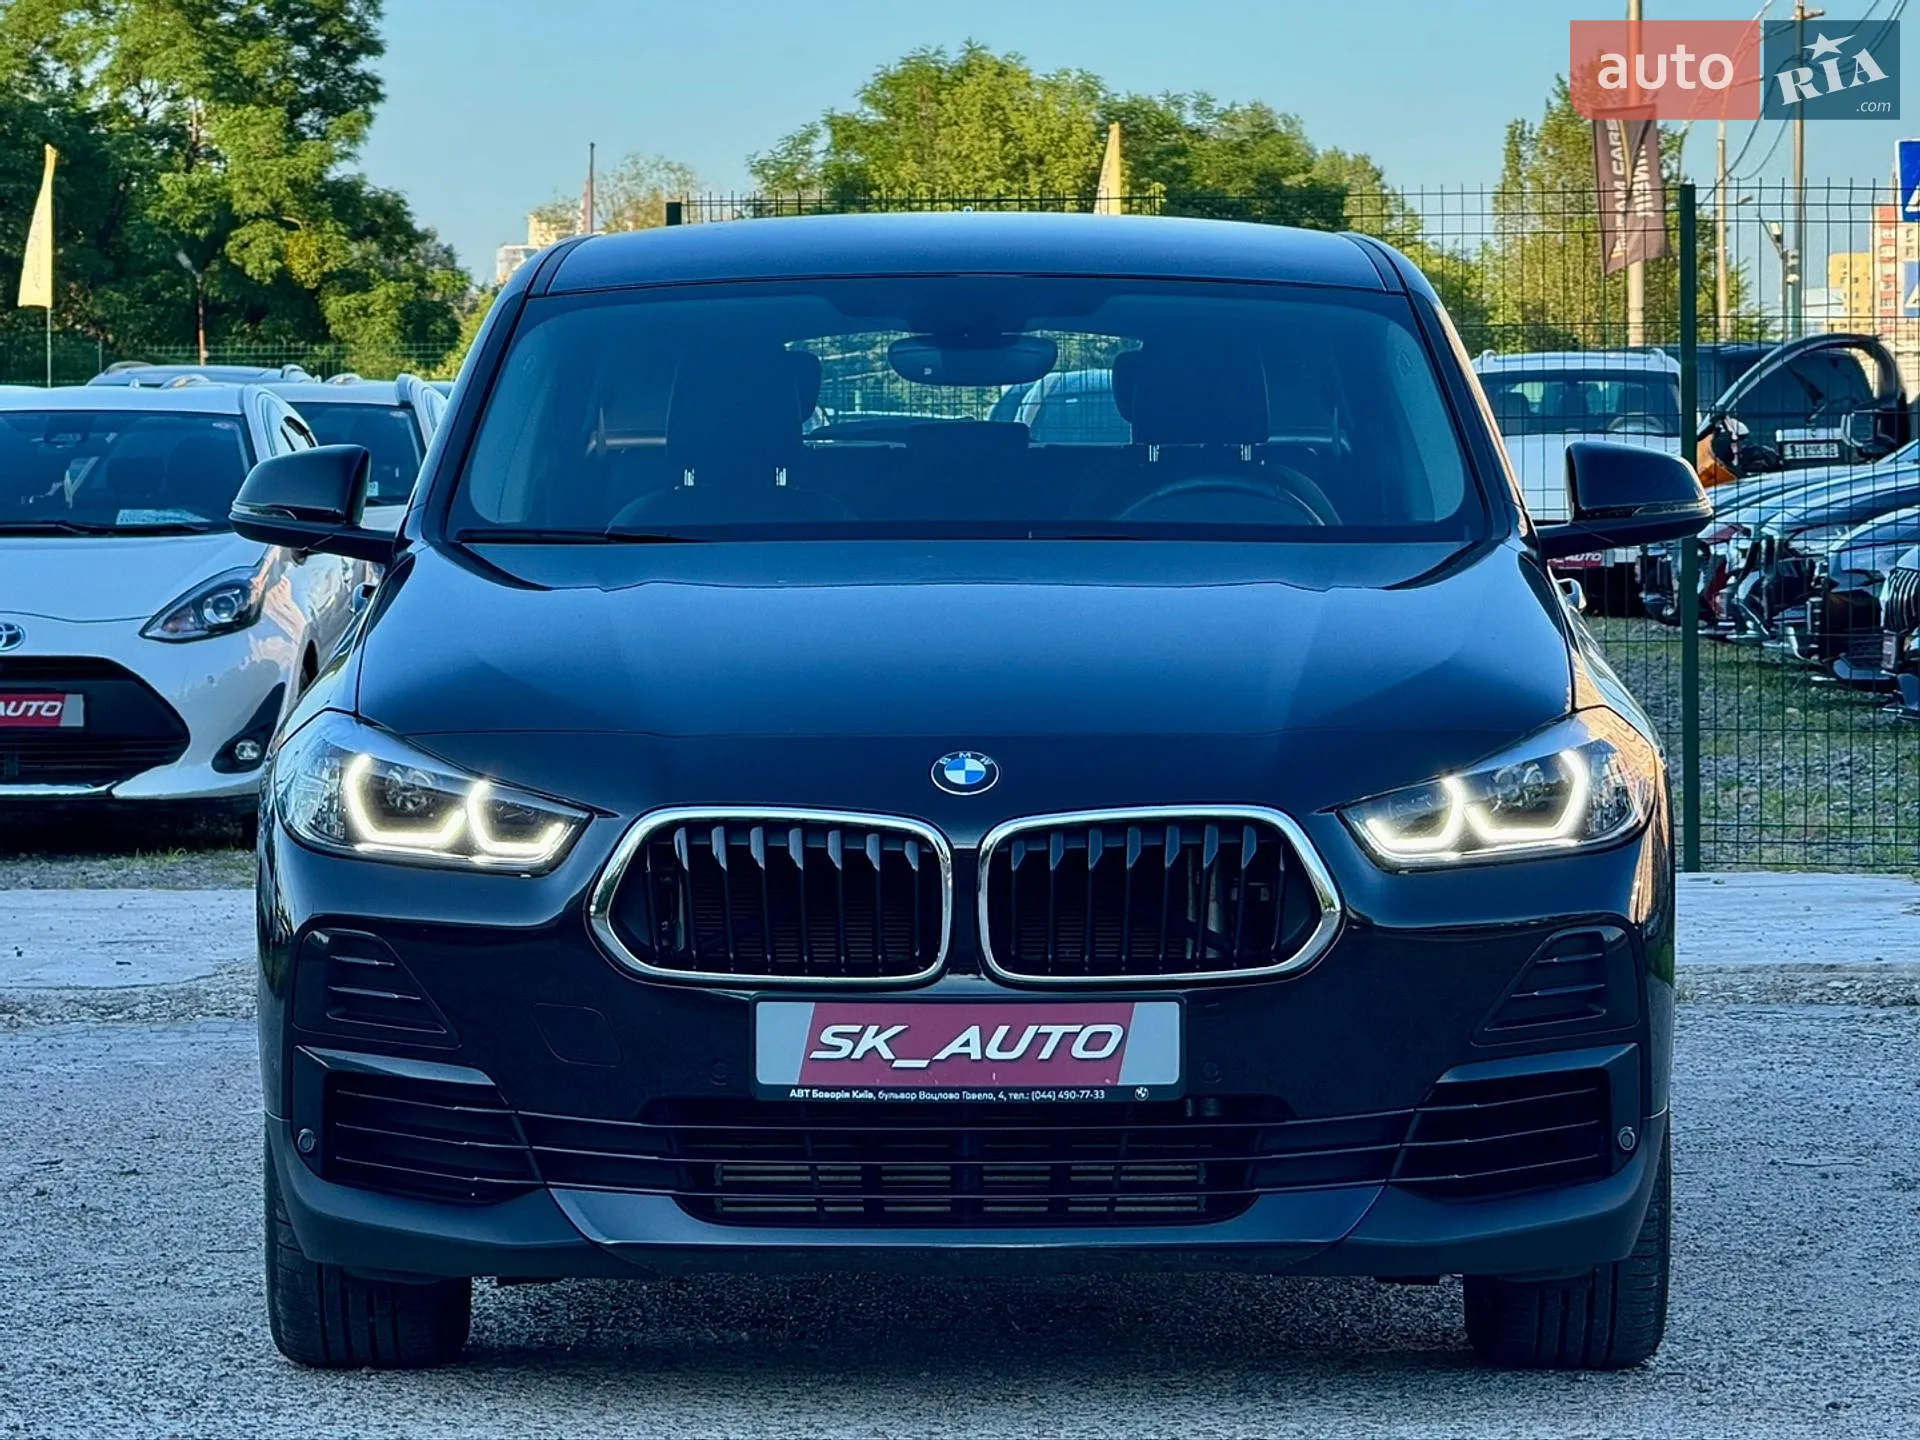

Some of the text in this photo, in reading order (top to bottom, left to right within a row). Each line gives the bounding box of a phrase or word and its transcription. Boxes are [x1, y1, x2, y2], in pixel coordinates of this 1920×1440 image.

[809, 1025, 1124, 1068] SK_AUTO
[1031, 1090, 1056, 1101] (044)
[1057, 1089, 1105, 1100] 490-77-33
